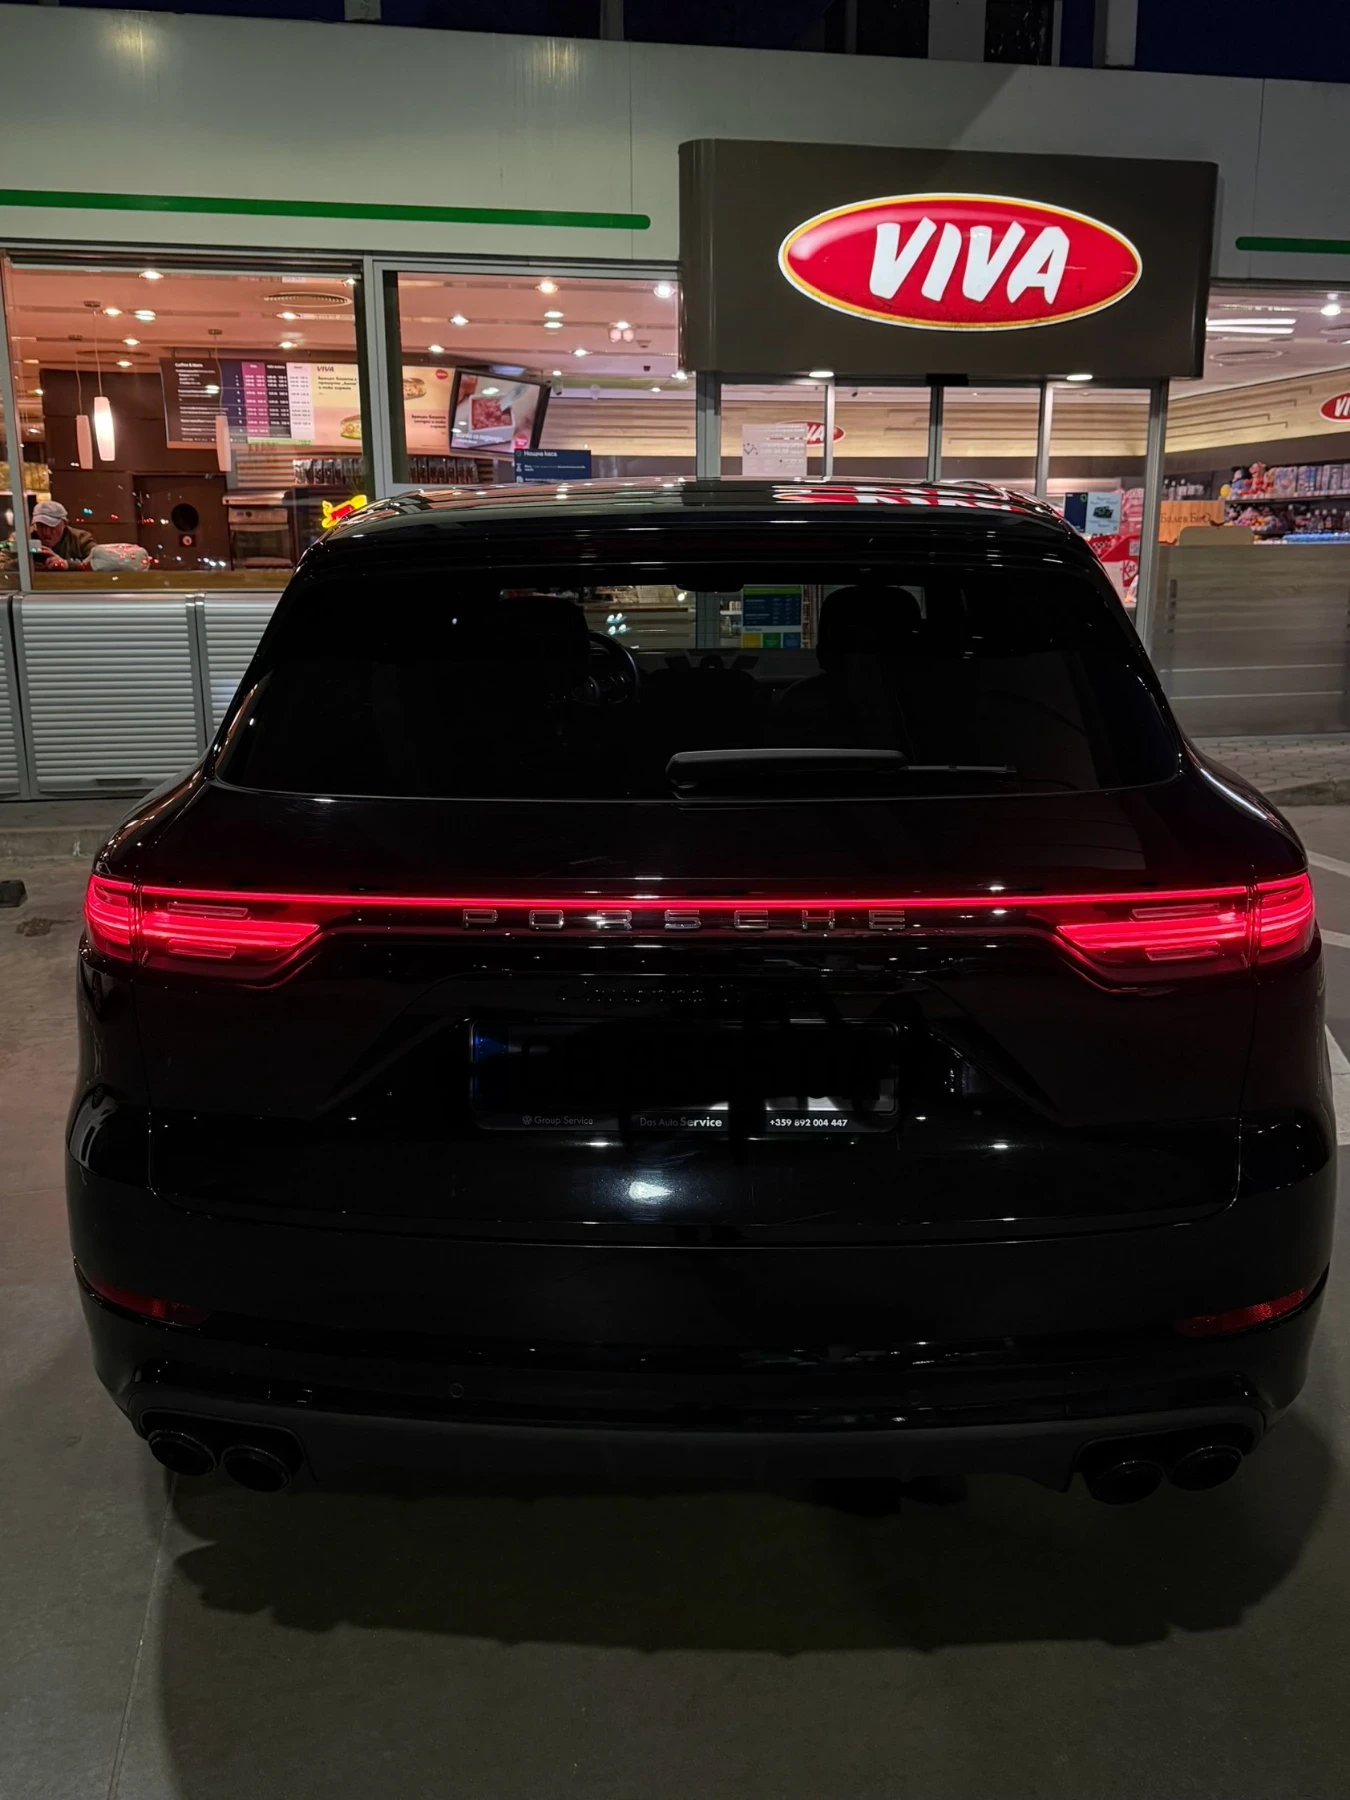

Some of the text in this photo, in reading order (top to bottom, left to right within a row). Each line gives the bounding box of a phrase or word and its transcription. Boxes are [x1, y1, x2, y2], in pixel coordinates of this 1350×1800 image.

[868, 216, 1070, 305] VIVA
[1334, 396, 1350, 417] VI
[462, 909, 906, 931] PORSCHE
[534, 1115, 594, 1127] Group Service
[639, 1115, 724, 1127] Das Auto Service
[769, 1118, 848, 1127] +359 892 004 447
